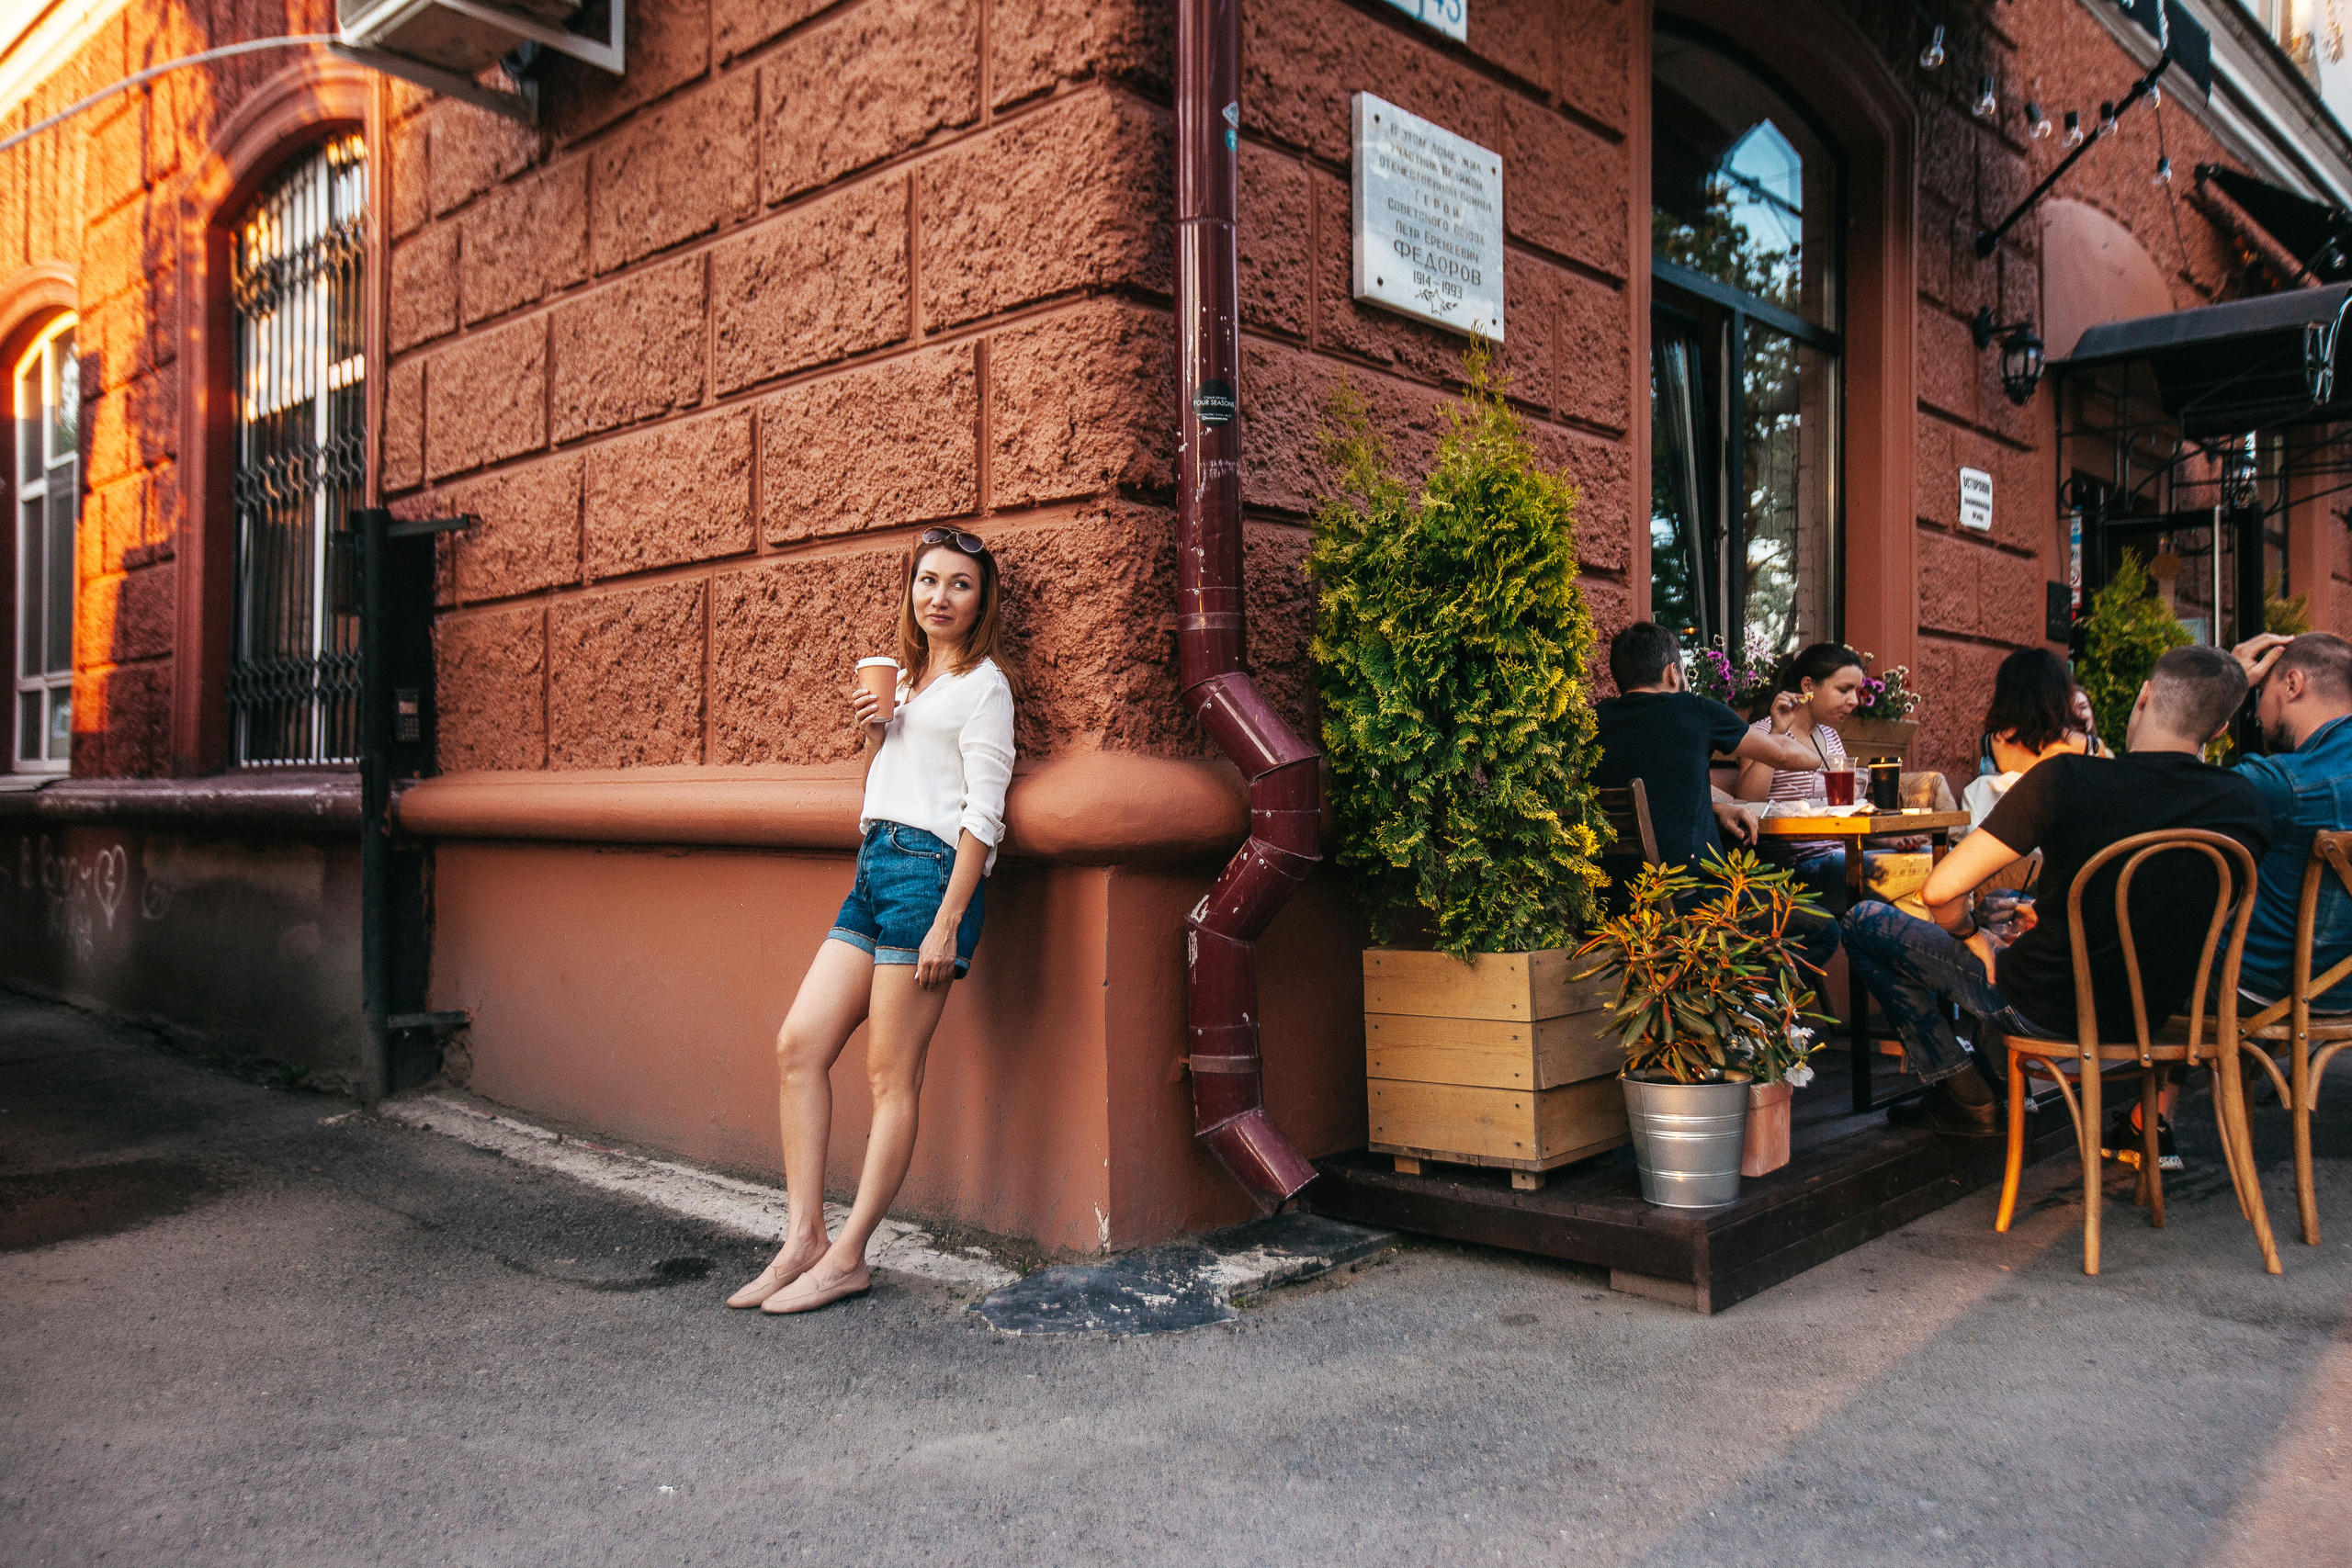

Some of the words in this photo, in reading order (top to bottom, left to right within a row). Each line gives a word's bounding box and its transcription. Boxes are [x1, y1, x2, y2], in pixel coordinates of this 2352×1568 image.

[1390, 142, 1438, 173] УЧАСТНИК
[1402, 130, 1426, 148] ЭТОМ
[1430, 142, 1455, 162] ДОМЕ
[1462, 157, 1481, 173] ЖИЛ
[1388, 197, 1449, 231] СОВЕТСКОГО
[1453, 223, 1485, 246] СОЮЗА
[1396, 219, 1419, 239] ПЕТР
[1425, 231, 1478, 264] ЕРЕМЕЕВИЧ
[1394, 239, 1481, 286] ФЕДОРОВ
[1211, 400, 1235, 408] SEASONS
